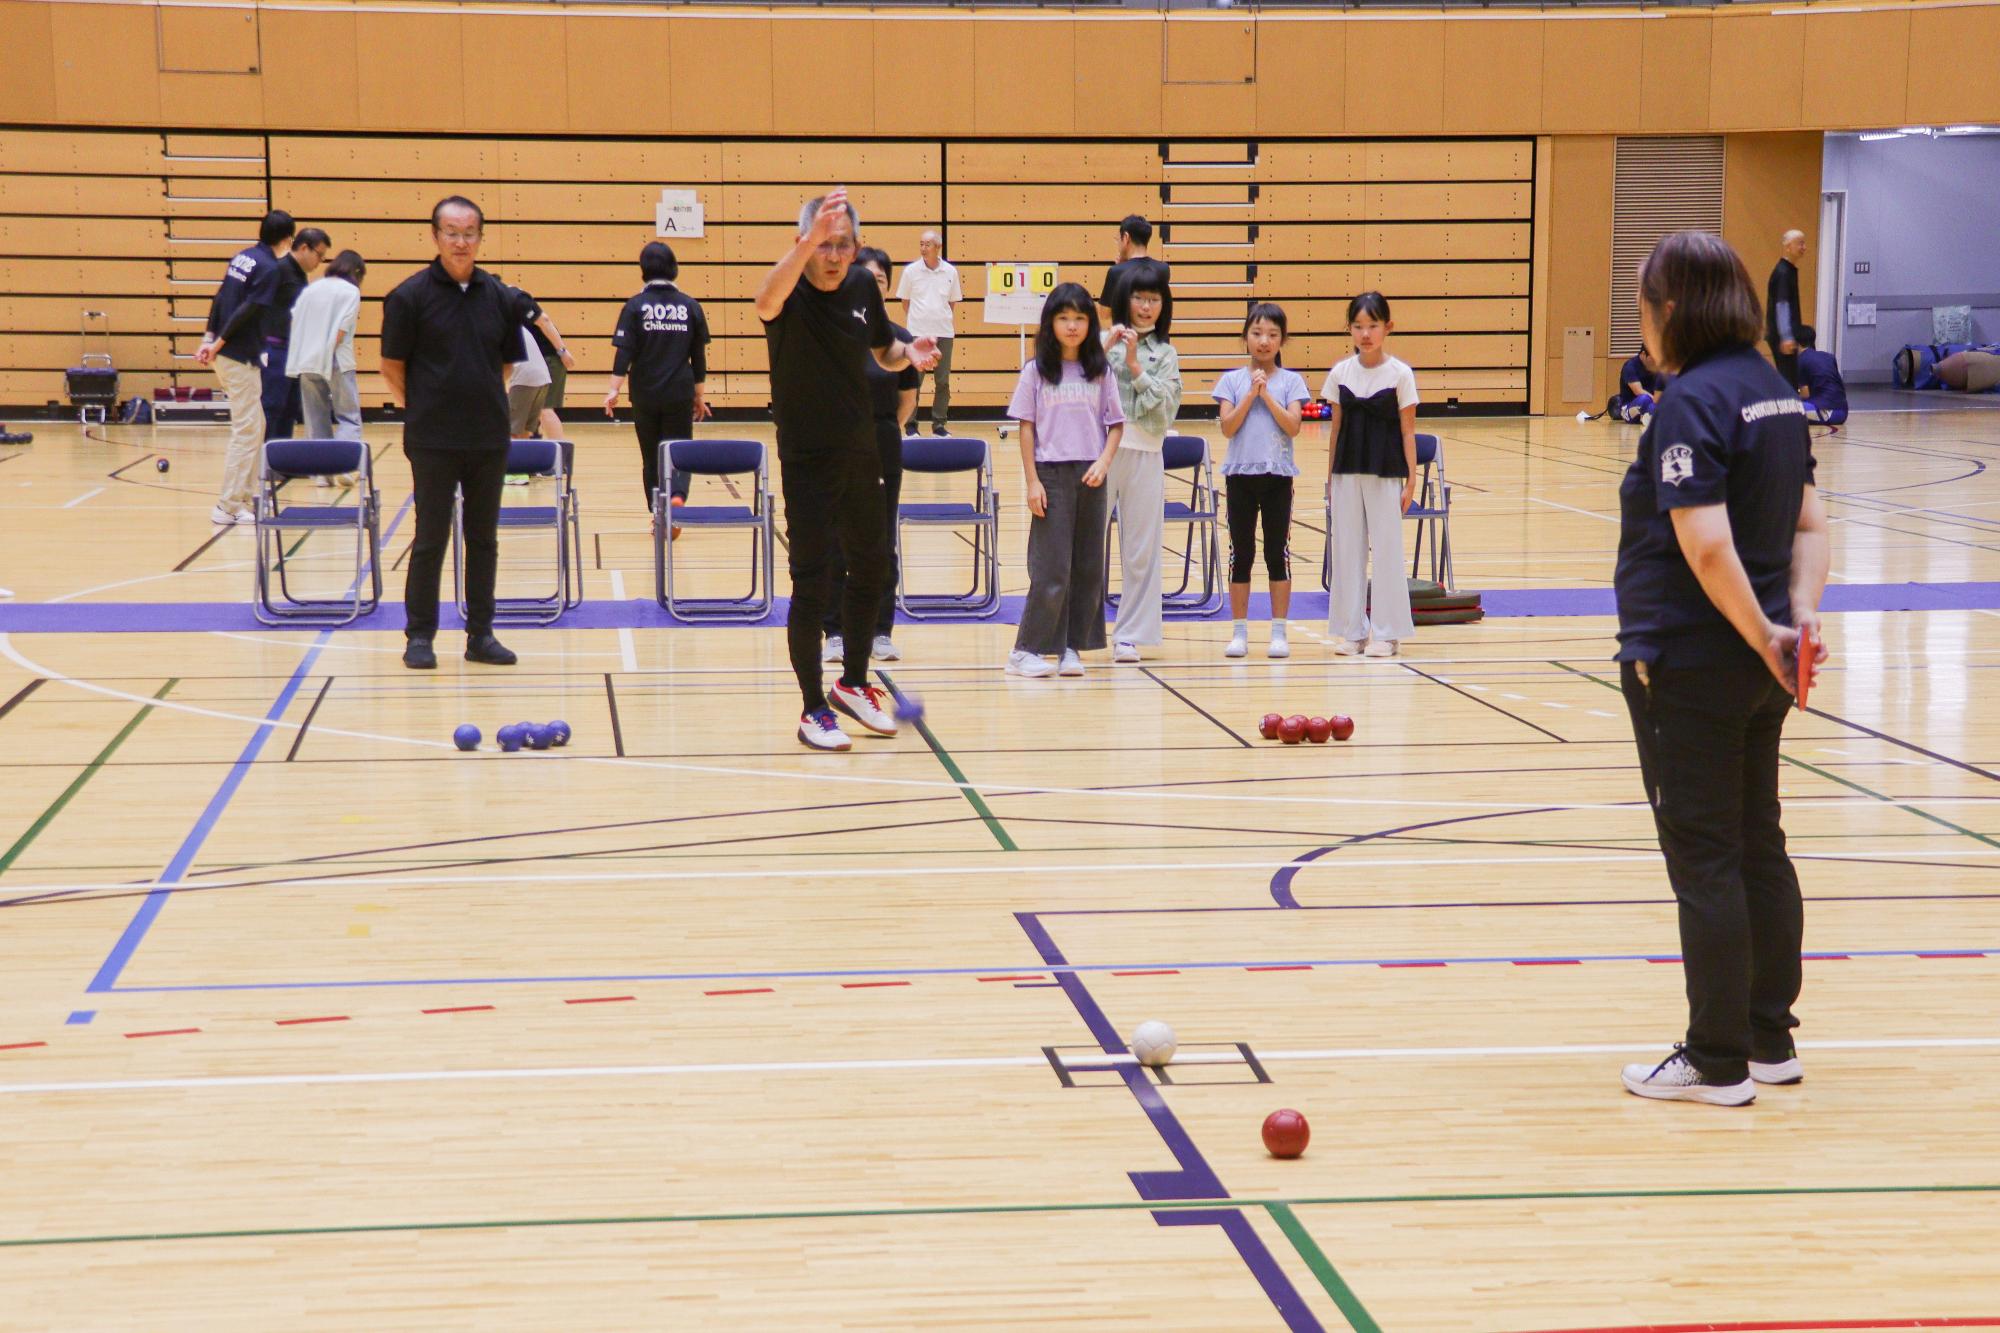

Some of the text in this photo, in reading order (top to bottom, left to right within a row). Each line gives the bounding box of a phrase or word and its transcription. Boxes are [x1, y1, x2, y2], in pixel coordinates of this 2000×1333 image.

[664, 217, 677, 232] A
[1003, 272, 1053, 288] 0 1 0
[641, 304, 688, 320] 2028
[643, 320, 688, 332] Chikuma
